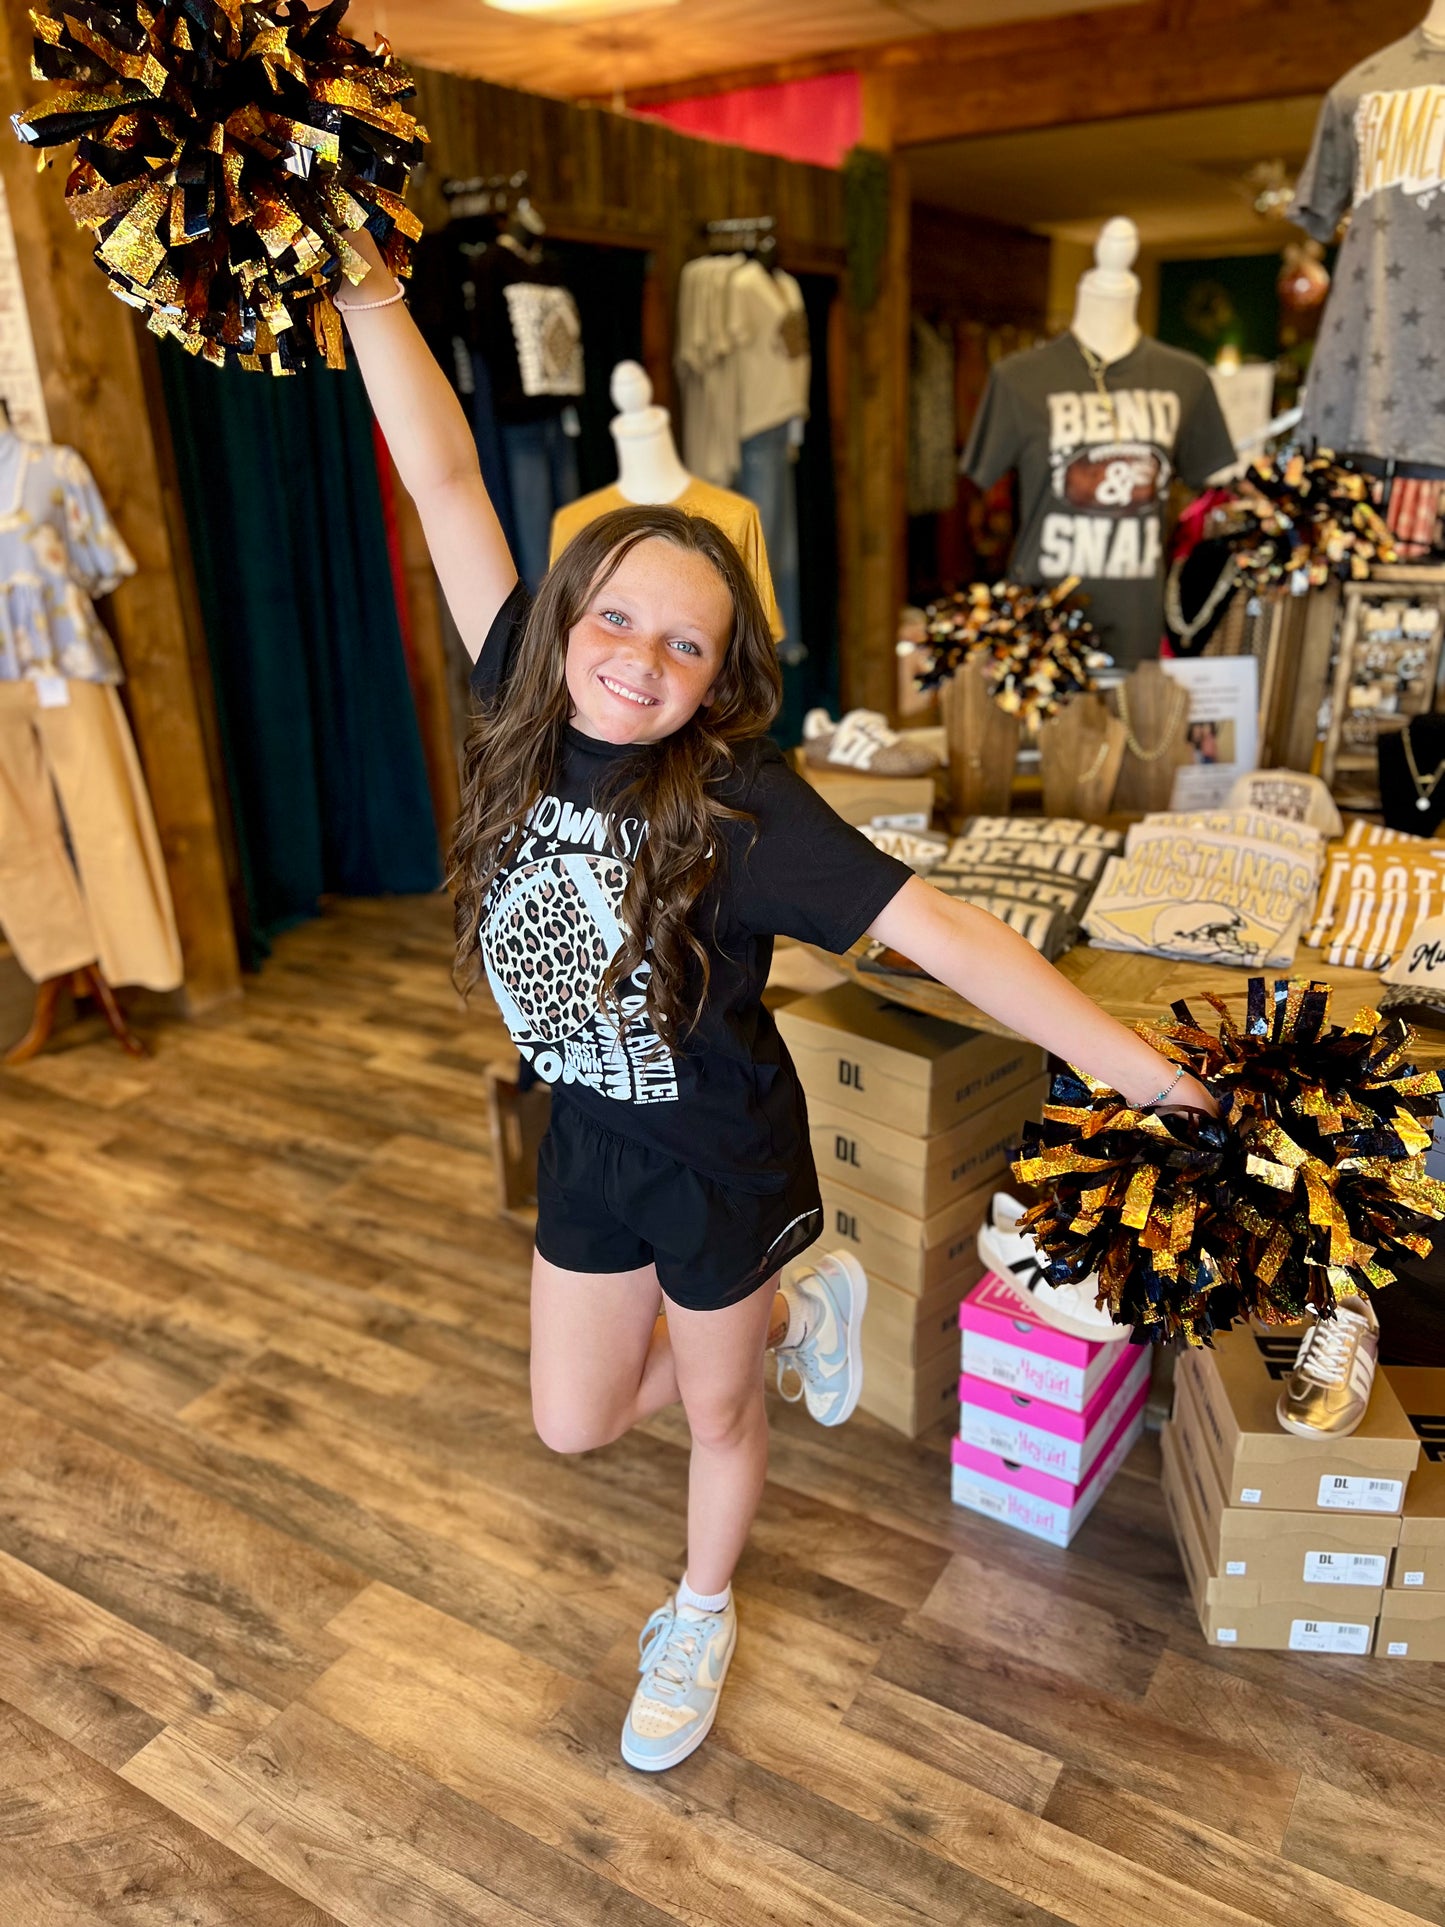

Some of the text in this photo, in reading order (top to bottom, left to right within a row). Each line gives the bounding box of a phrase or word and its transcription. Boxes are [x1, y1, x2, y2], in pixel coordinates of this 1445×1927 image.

[1047, 389, 1181, 450] BEND
[563, 1038, 599, 1060] FIRST
[838, 1058, 865, 1092] DL
[834, 1135, 860, 1168] DL
[836, 1210, 860, 1243] DL
[1333, 1477, 1349, 1489] DL
[1319, 1553, 1334, 1565] DL
[1304, 1622, 1319, 1633] DL
